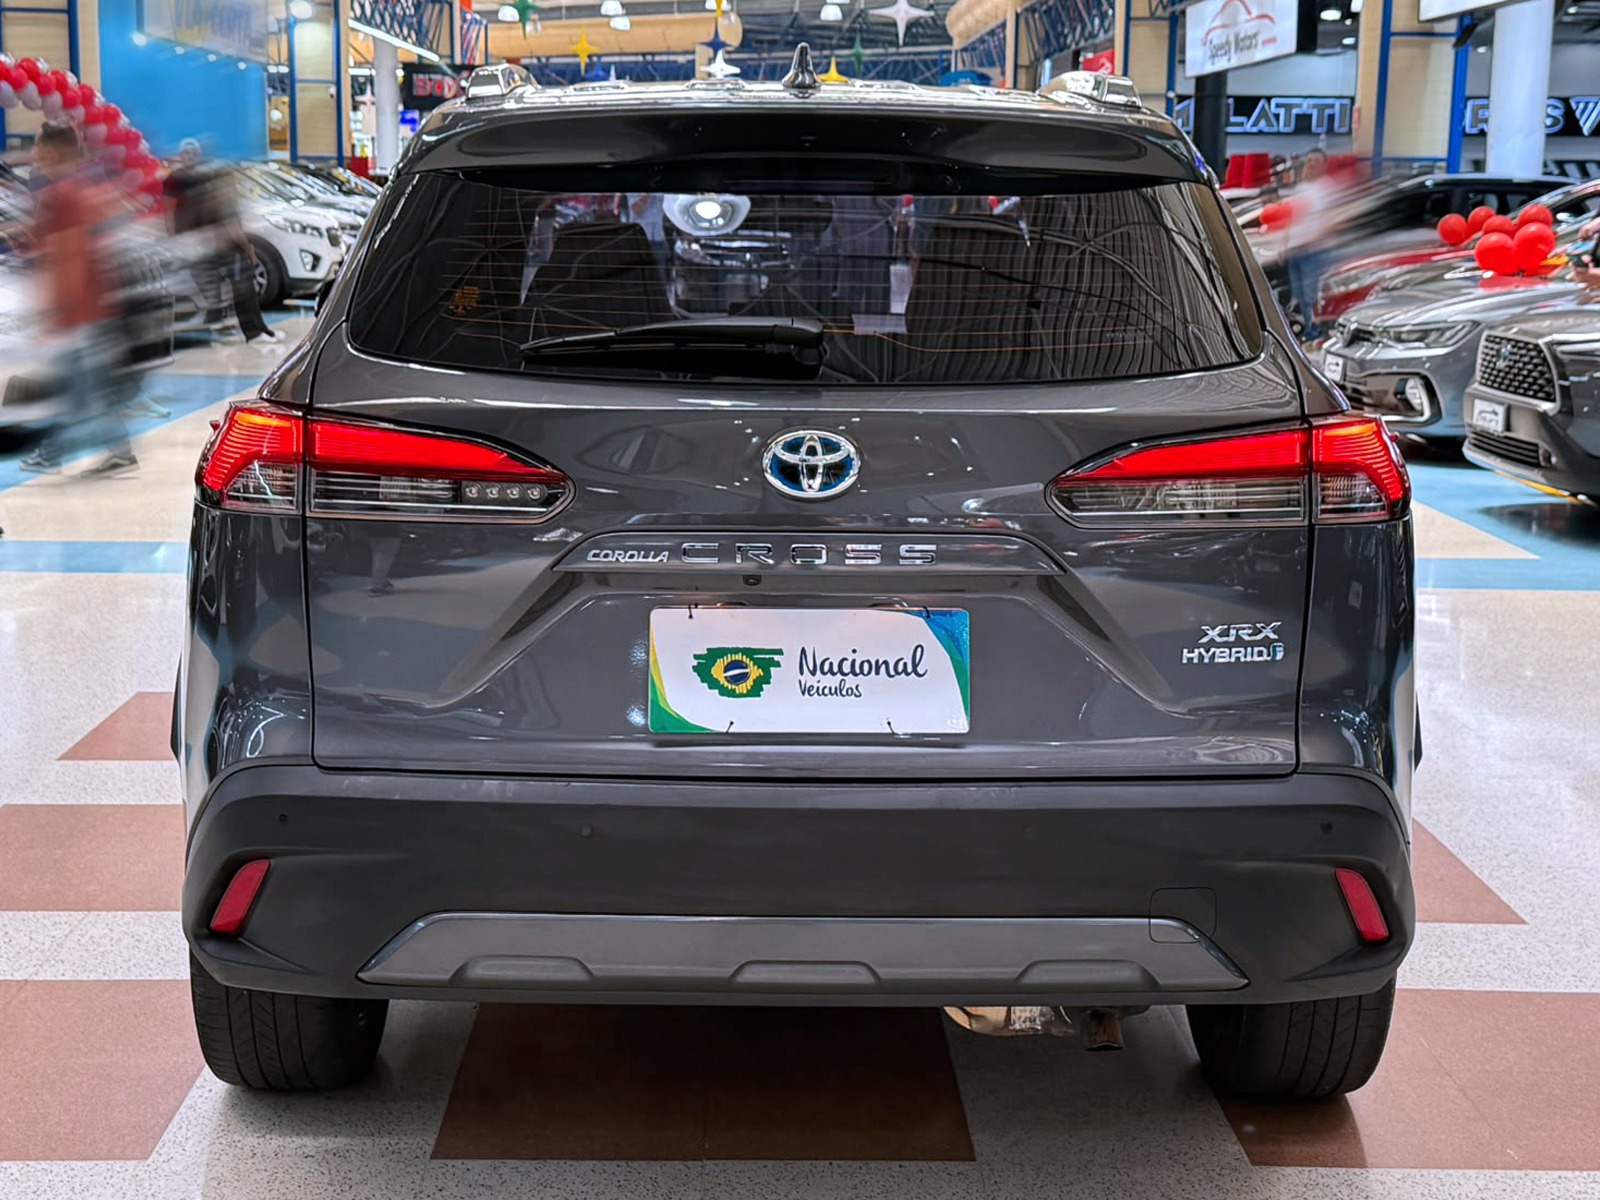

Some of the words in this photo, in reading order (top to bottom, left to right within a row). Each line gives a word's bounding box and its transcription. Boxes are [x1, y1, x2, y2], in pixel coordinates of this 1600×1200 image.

[586, 548, 669, 564] COROLLA
[681, 542, 938, 566] CROSS
[1198, 621, 1282, 644] XRX
[798, 643, 928, 679] Nacional
[1181, 645, 1269, 664] HYBRID
